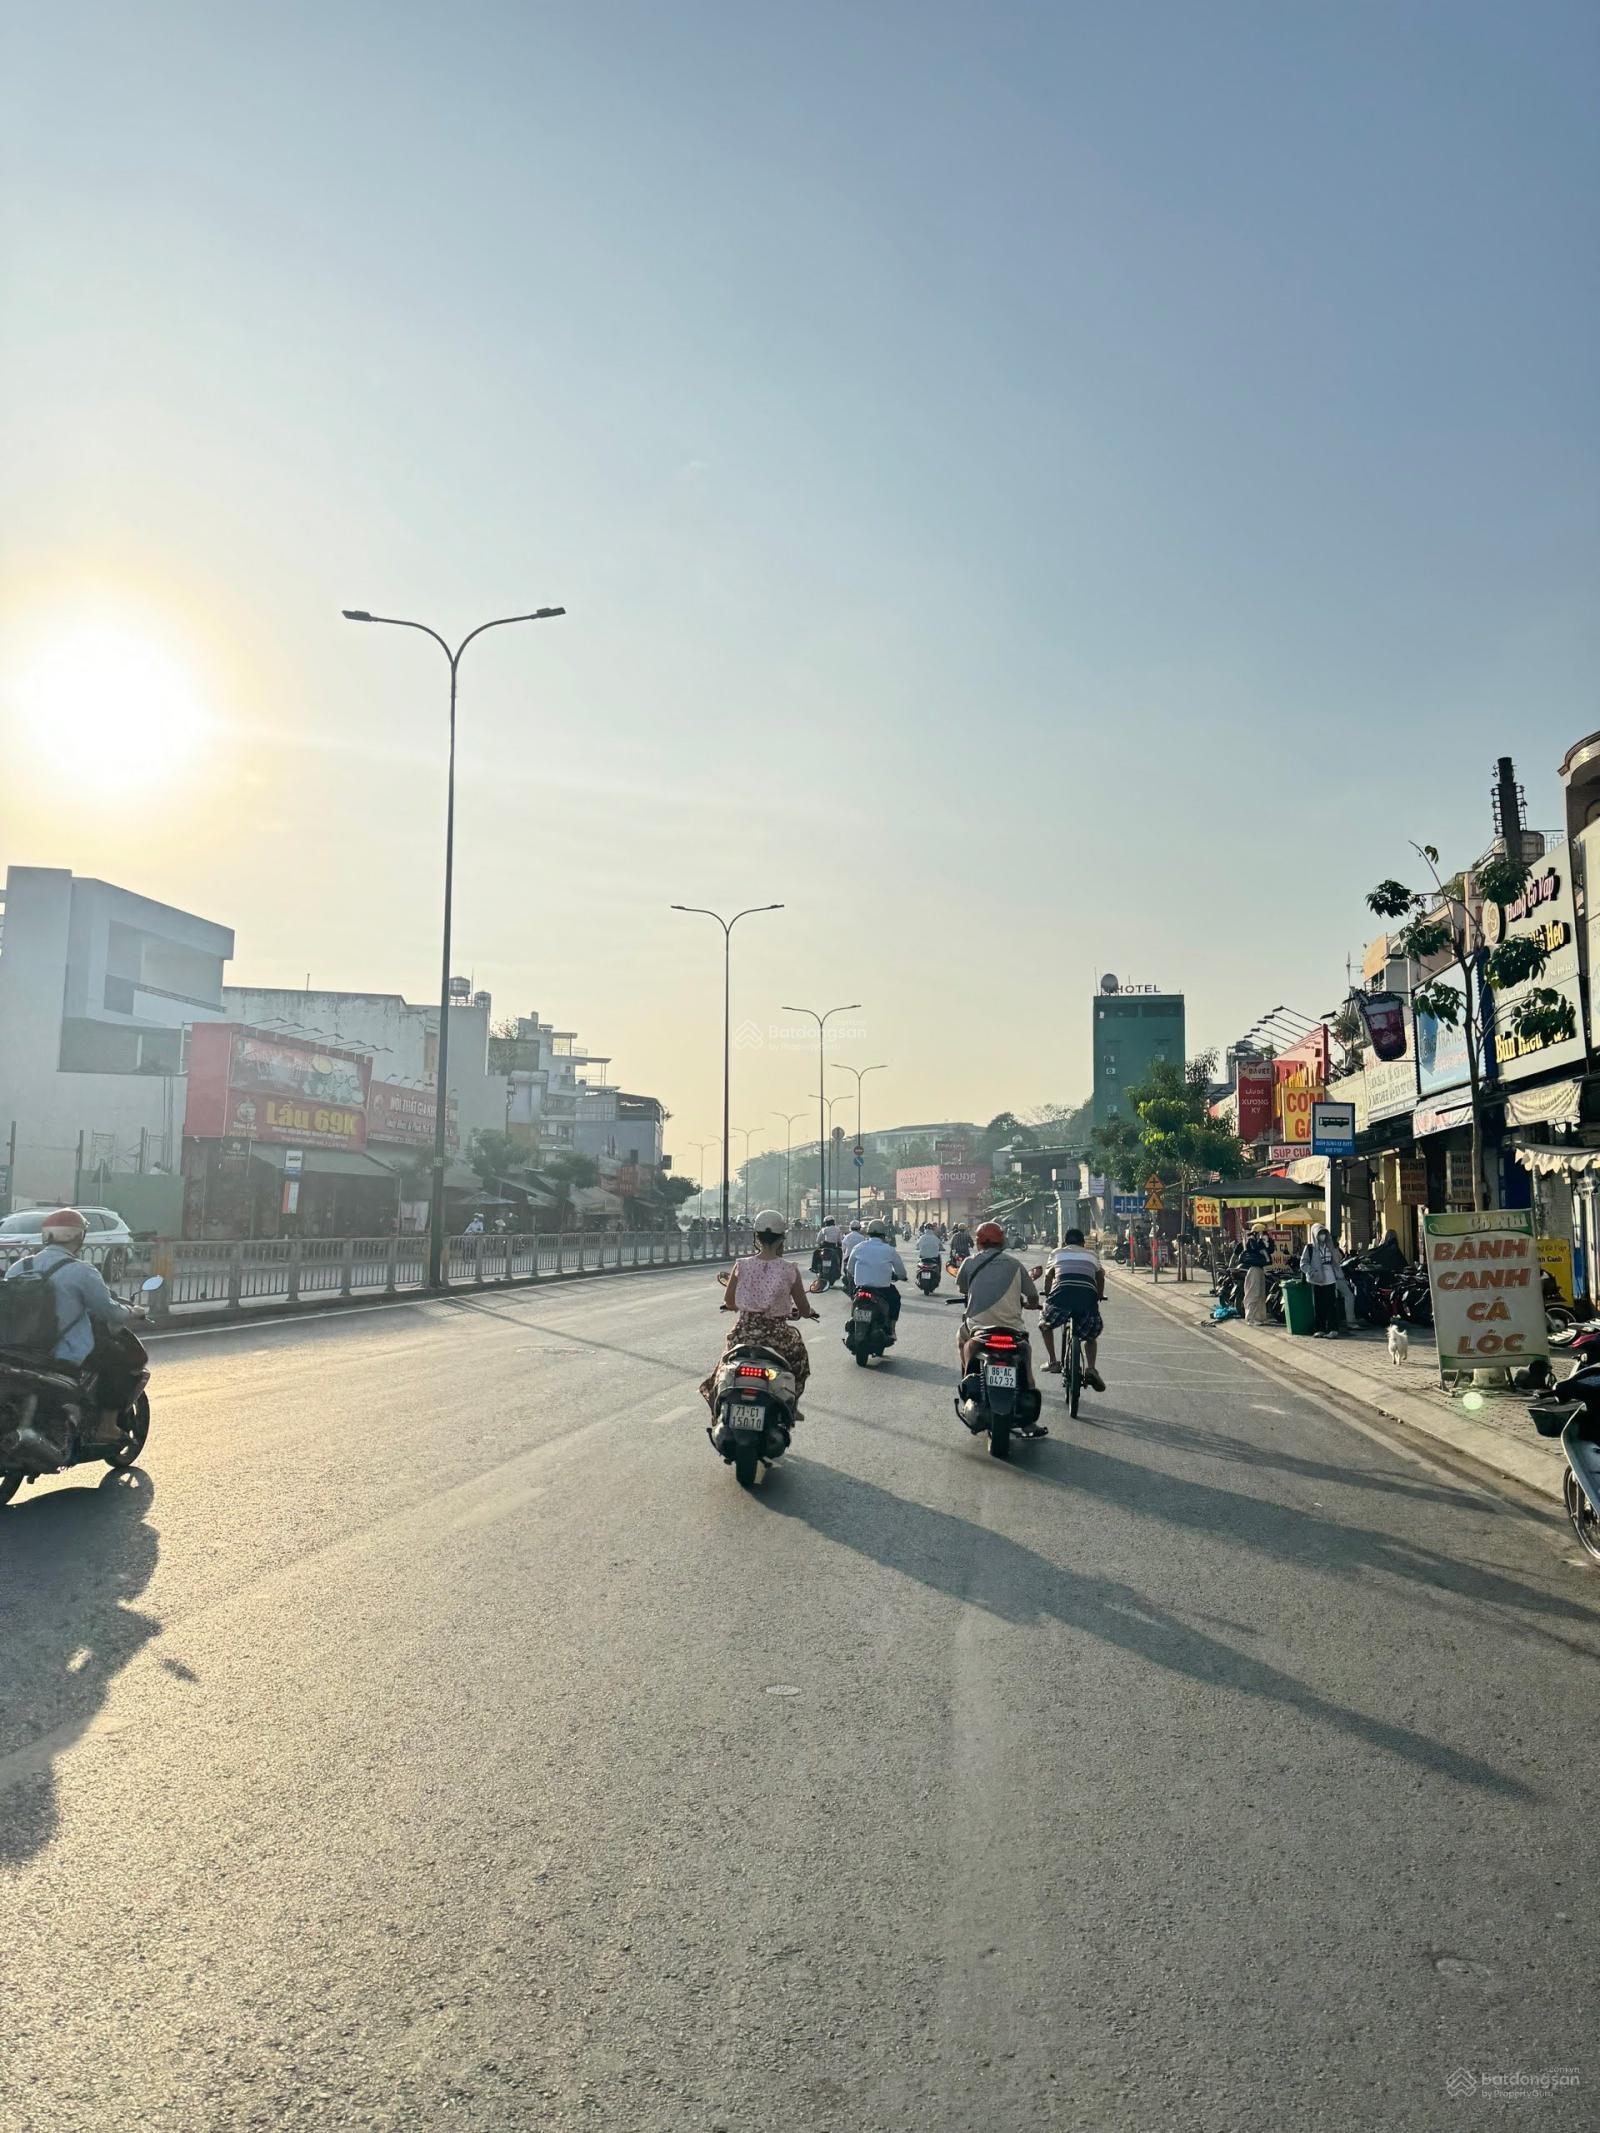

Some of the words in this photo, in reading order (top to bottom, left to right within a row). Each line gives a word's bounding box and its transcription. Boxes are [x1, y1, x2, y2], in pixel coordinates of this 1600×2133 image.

[1115, 984, 1161, 994] HOTEL
[314, 1109, 361, 1135] 69K
[1197, 1216, 1219, 1225] 20K
[1434, 1236, 1530, 1261] BÁNH
[1438, 1268, 1531, 1290] CANH
[1467, 1296, 1512, 1321] CÁ
[1457, 1329, 1526, 1354] LÓC
